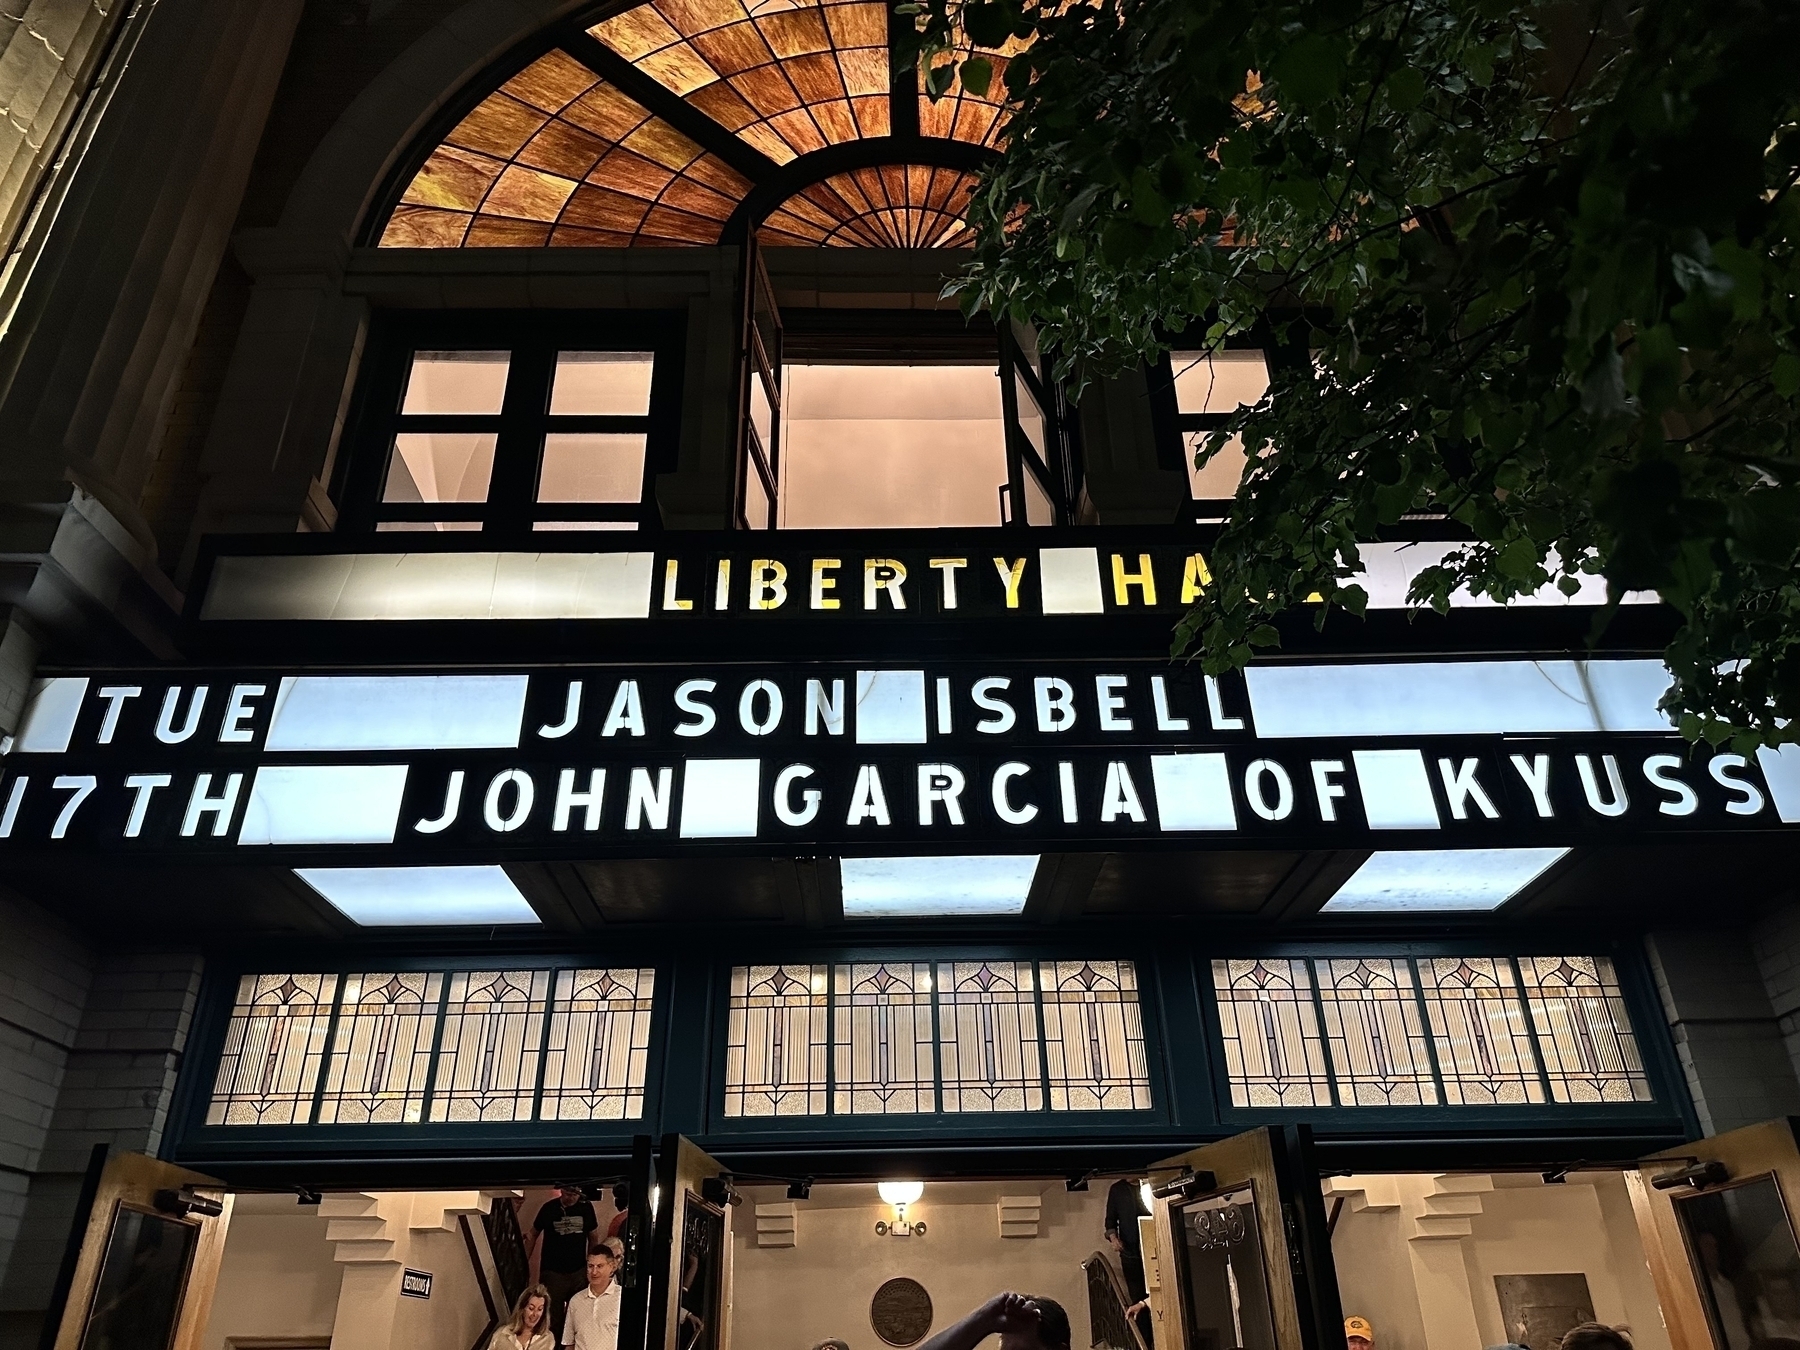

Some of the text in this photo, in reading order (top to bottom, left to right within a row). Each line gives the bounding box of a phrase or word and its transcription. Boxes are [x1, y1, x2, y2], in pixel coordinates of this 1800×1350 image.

[662, 558, 1027, 611] LIBERTY
[98, 674, 1246, 745] TUE JASON ISBELL
[0, 752, 1766, 839] 17TH JOHN GARCIA OF KYUSS
